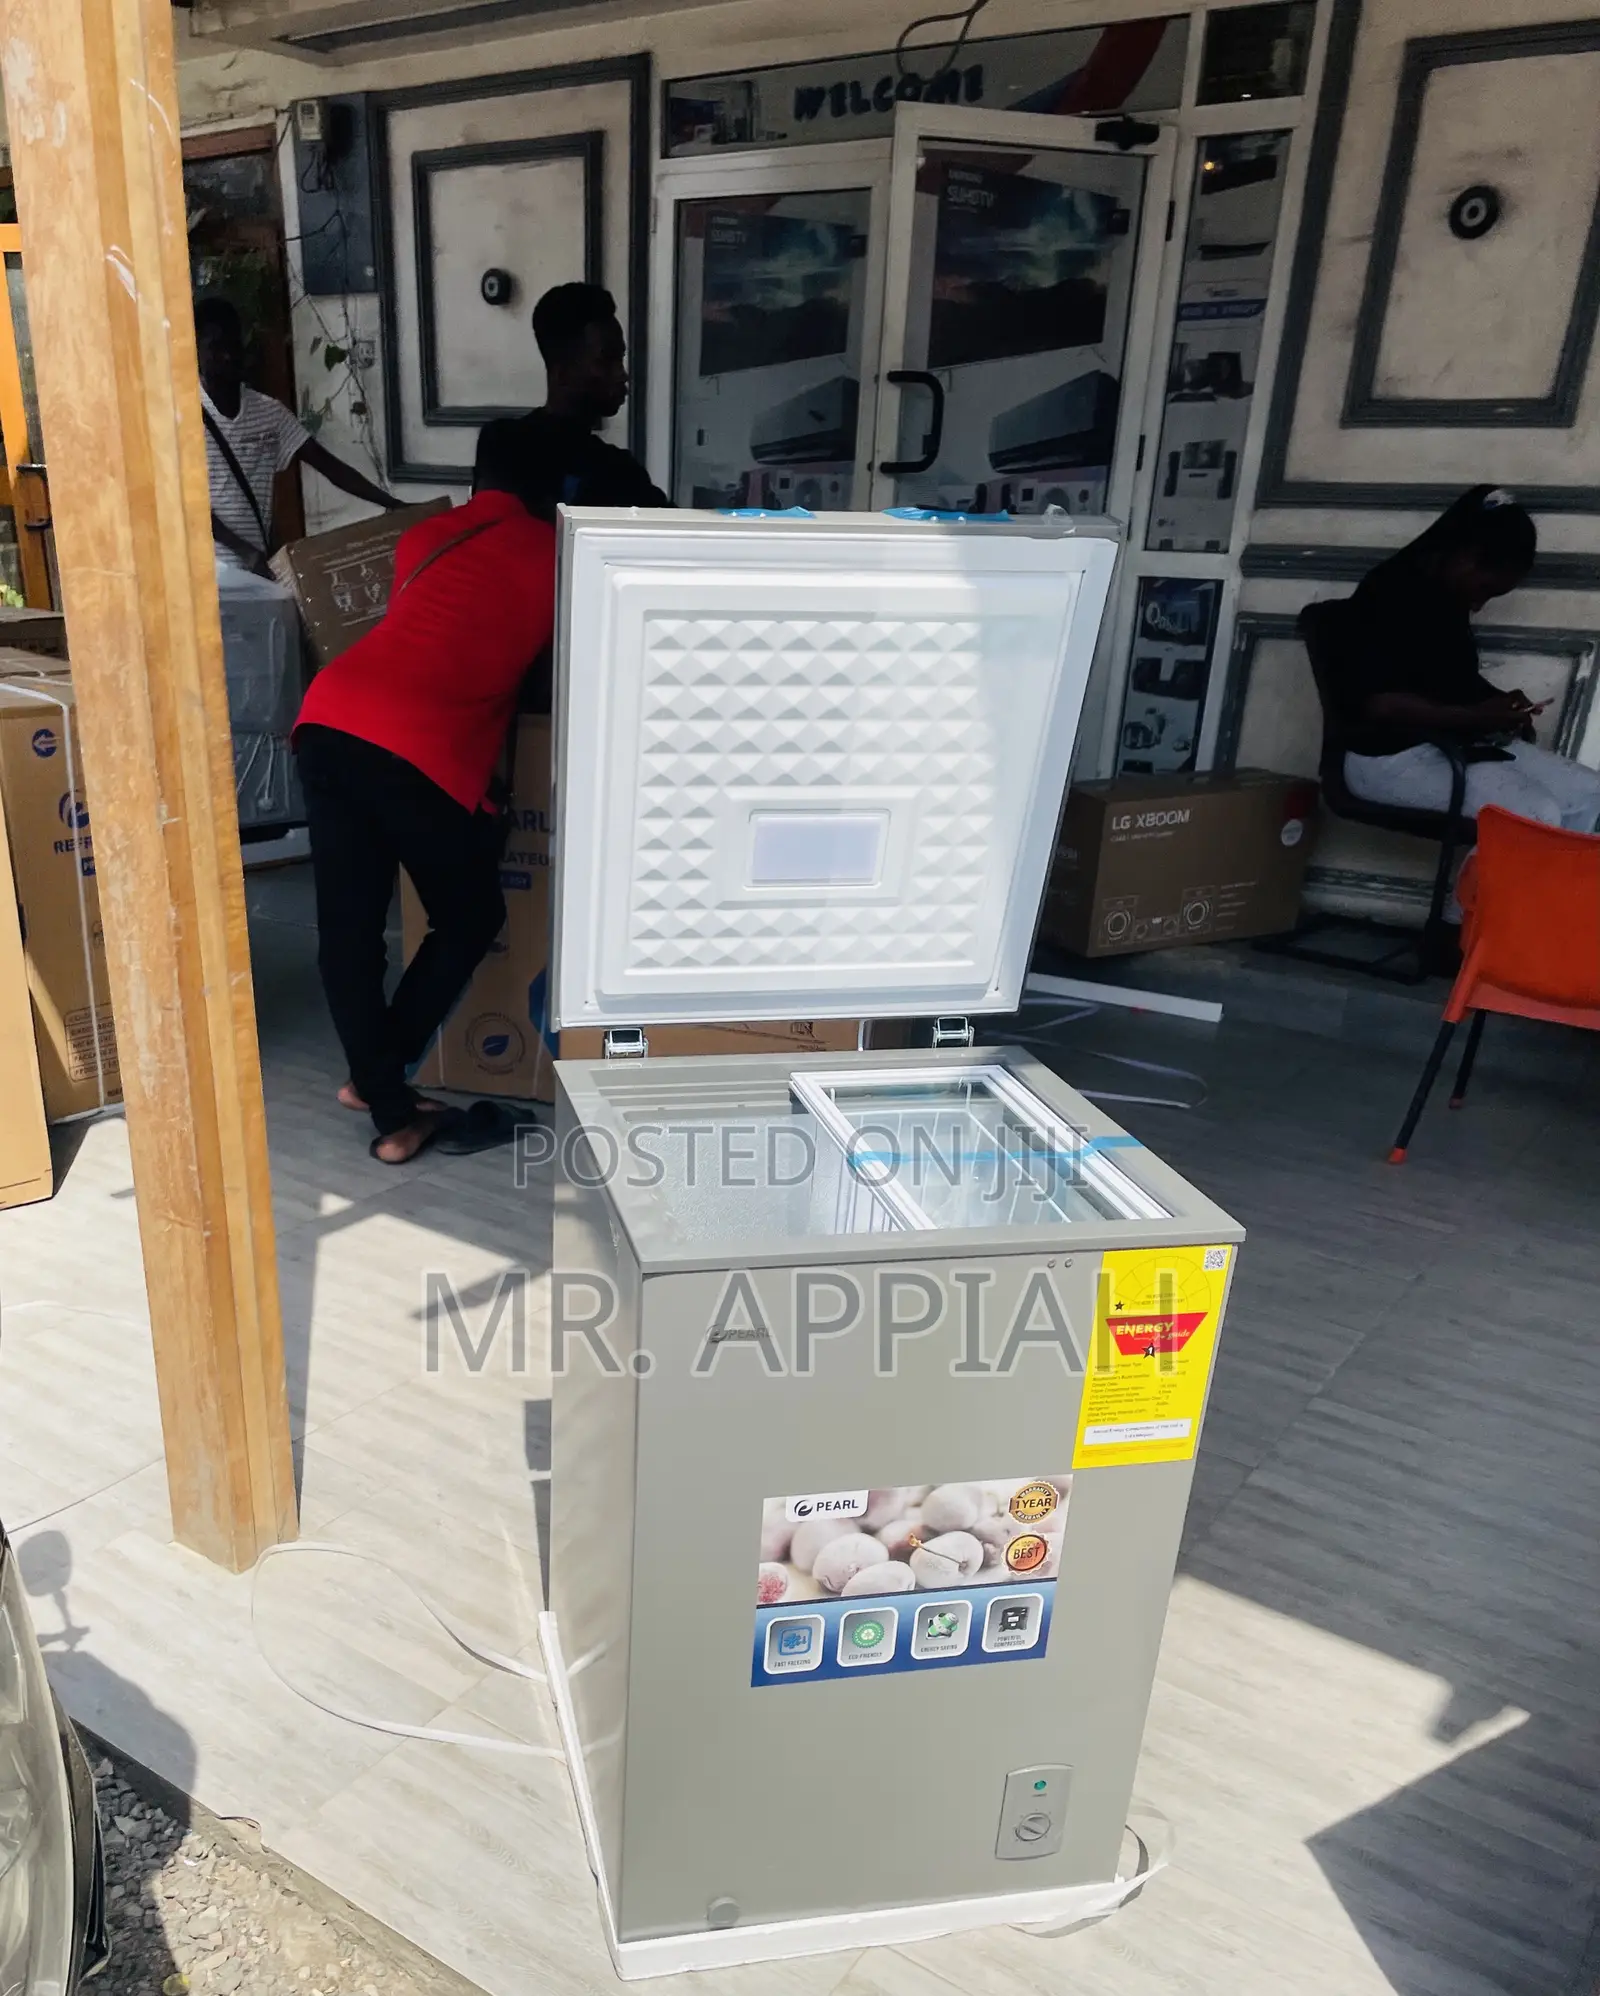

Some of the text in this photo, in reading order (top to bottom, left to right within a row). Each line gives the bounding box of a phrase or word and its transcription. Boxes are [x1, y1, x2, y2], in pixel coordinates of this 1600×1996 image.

[794, 65, 983, 121] WELCOME
[1112, 809, 1191, 830] LG XBOOM
[1115, 1321, 1175, 1338] ENERGY
[1020, 1486, 1051, 1497] WARRANTY
[816, 1499, 859, 1512] PEARL
[1015, 1498, 1052, 1509] 1 YEAR
[1013, 1546, 1040, 1560] BEST
